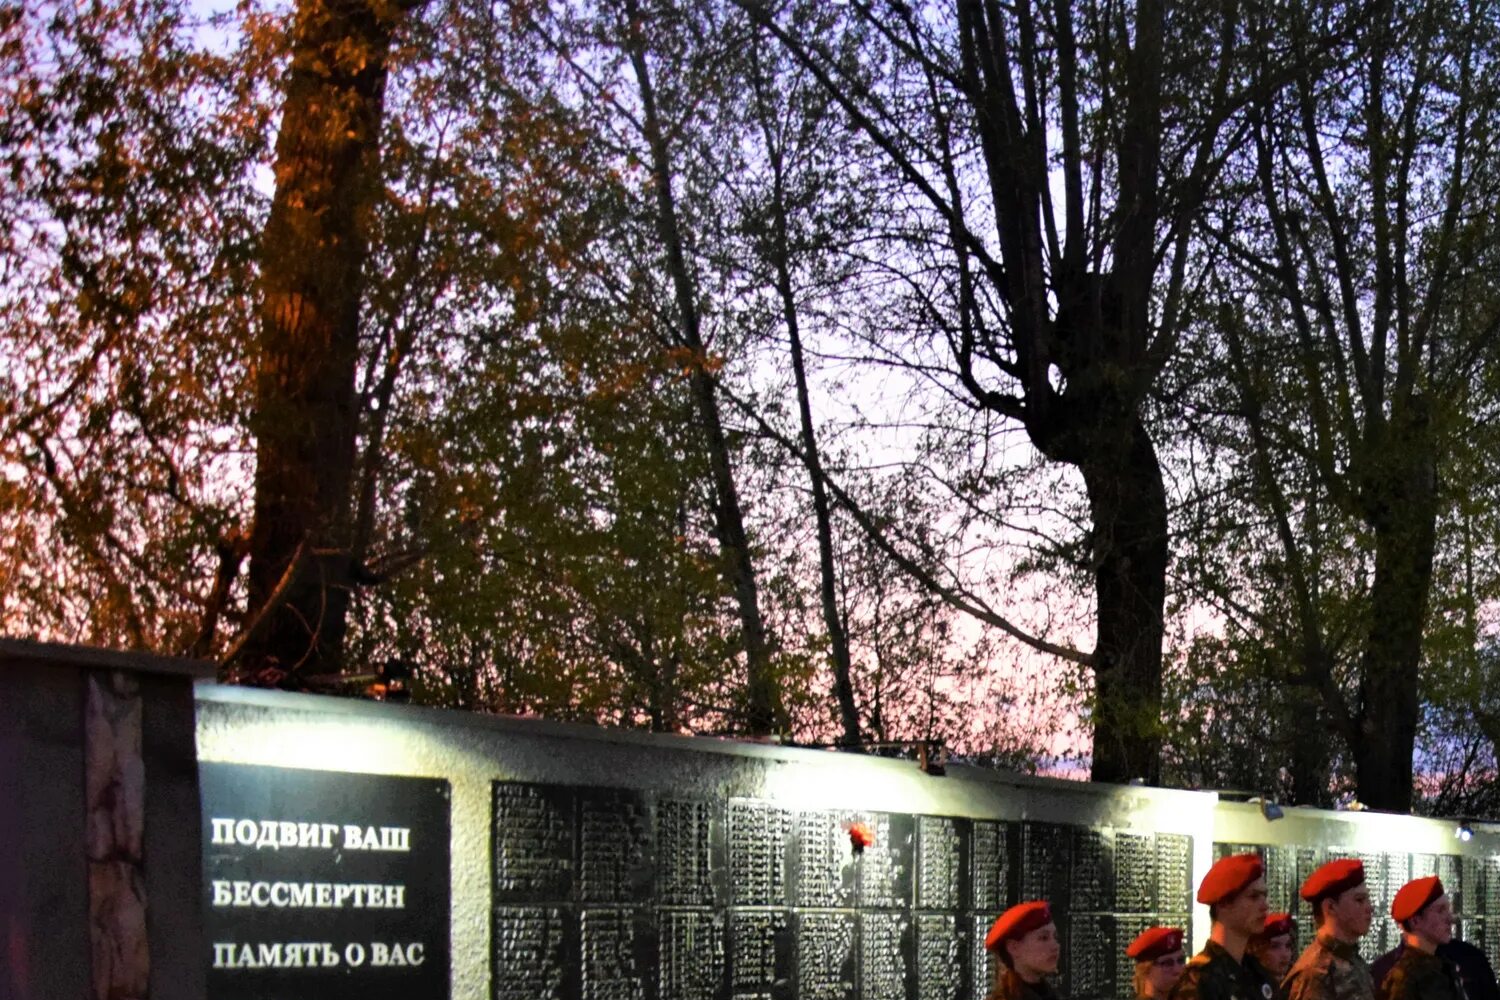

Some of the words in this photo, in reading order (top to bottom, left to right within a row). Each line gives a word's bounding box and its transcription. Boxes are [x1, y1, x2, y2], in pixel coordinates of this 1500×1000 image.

[212, 818, 339, 850] ПОДВИГ
[344, 825, 410, 851] ВАШ
[212, 880, 405, 908] БЕССМЕРТЕН
[213, 942, 339, 968] ПАМЯТЬ
[345, 943, 364, 966] О
[371, 942, 424, 966] ВАС
